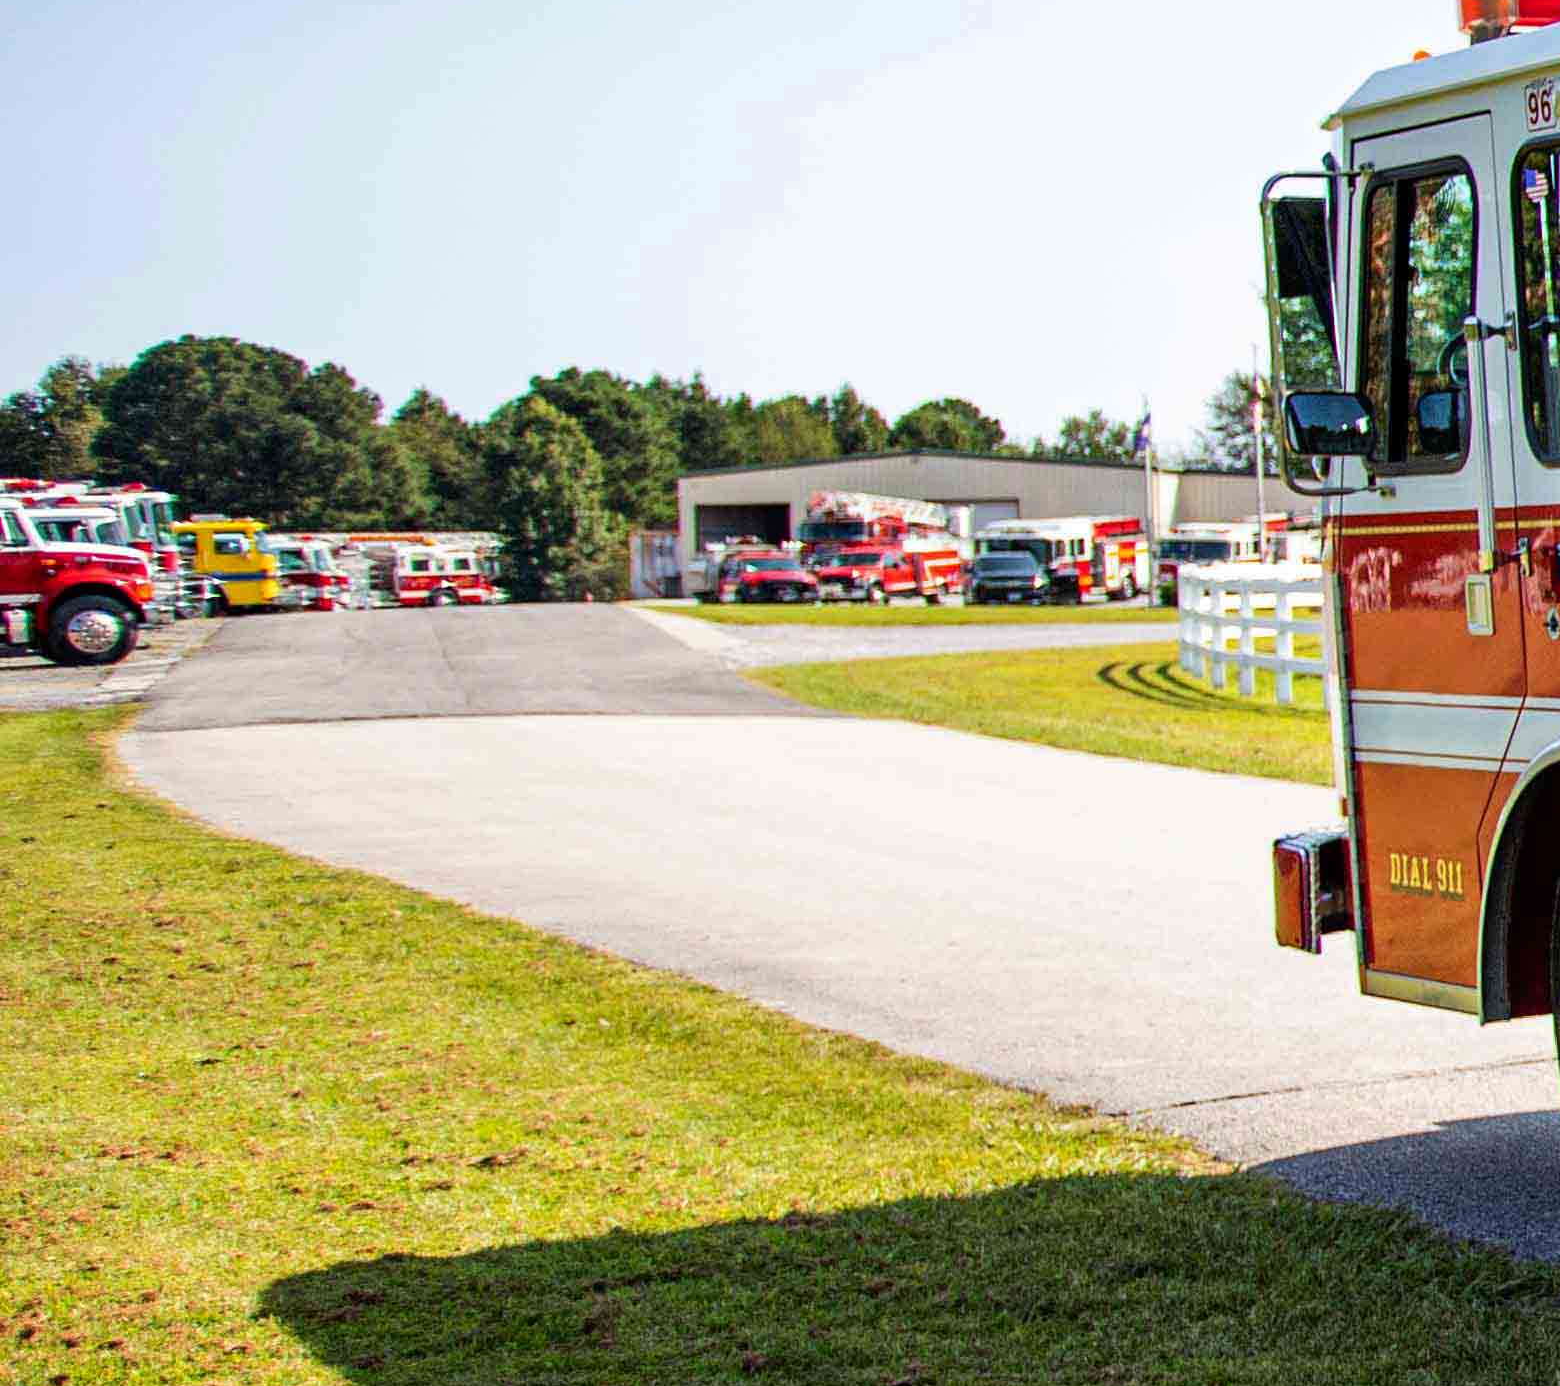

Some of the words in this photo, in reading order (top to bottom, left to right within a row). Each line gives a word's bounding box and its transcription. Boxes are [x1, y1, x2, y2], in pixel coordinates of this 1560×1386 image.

[1528, 89, 1552, 125] 96
[1390, 853, 1433, 891] DIAL
[1437, 858, 1464, 895] 911
